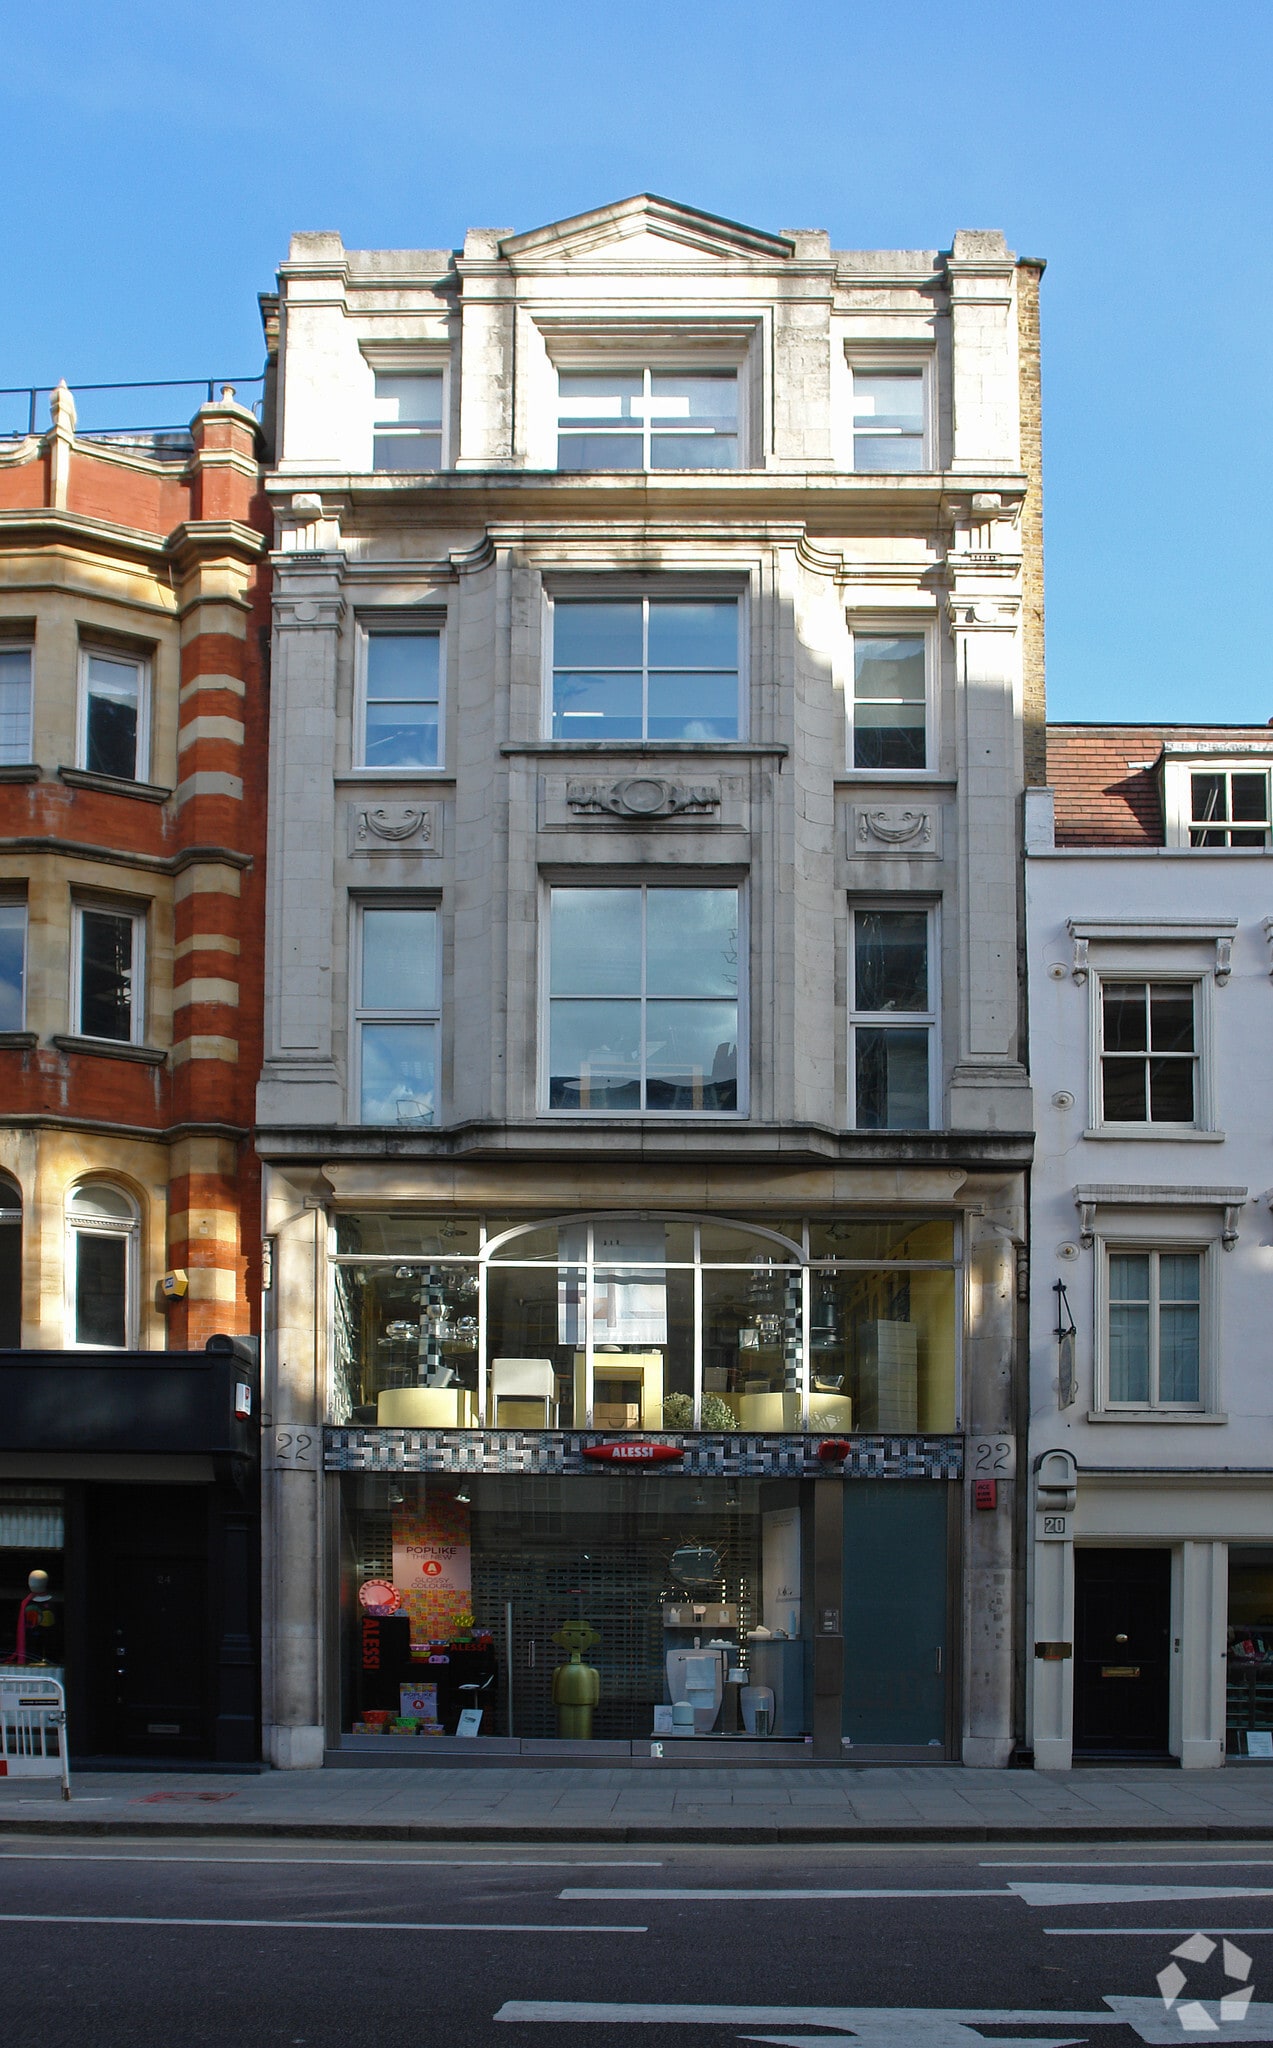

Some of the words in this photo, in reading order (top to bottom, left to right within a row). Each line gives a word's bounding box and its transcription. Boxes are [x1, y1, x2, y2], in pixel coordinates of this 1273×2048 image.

[276, 1432, 312, 1461] 22
[612, 1447, 654, 1457] ALESSI
[976, 1442, 1011, 1470] 22
[1045, 1518, 1065, 1533] 20
[406, 1546, 457, 1554] POPLIKE
[362, 1617, 380, 1669] ALESSI
[450, 1642, 488, 1651] ALESSI
